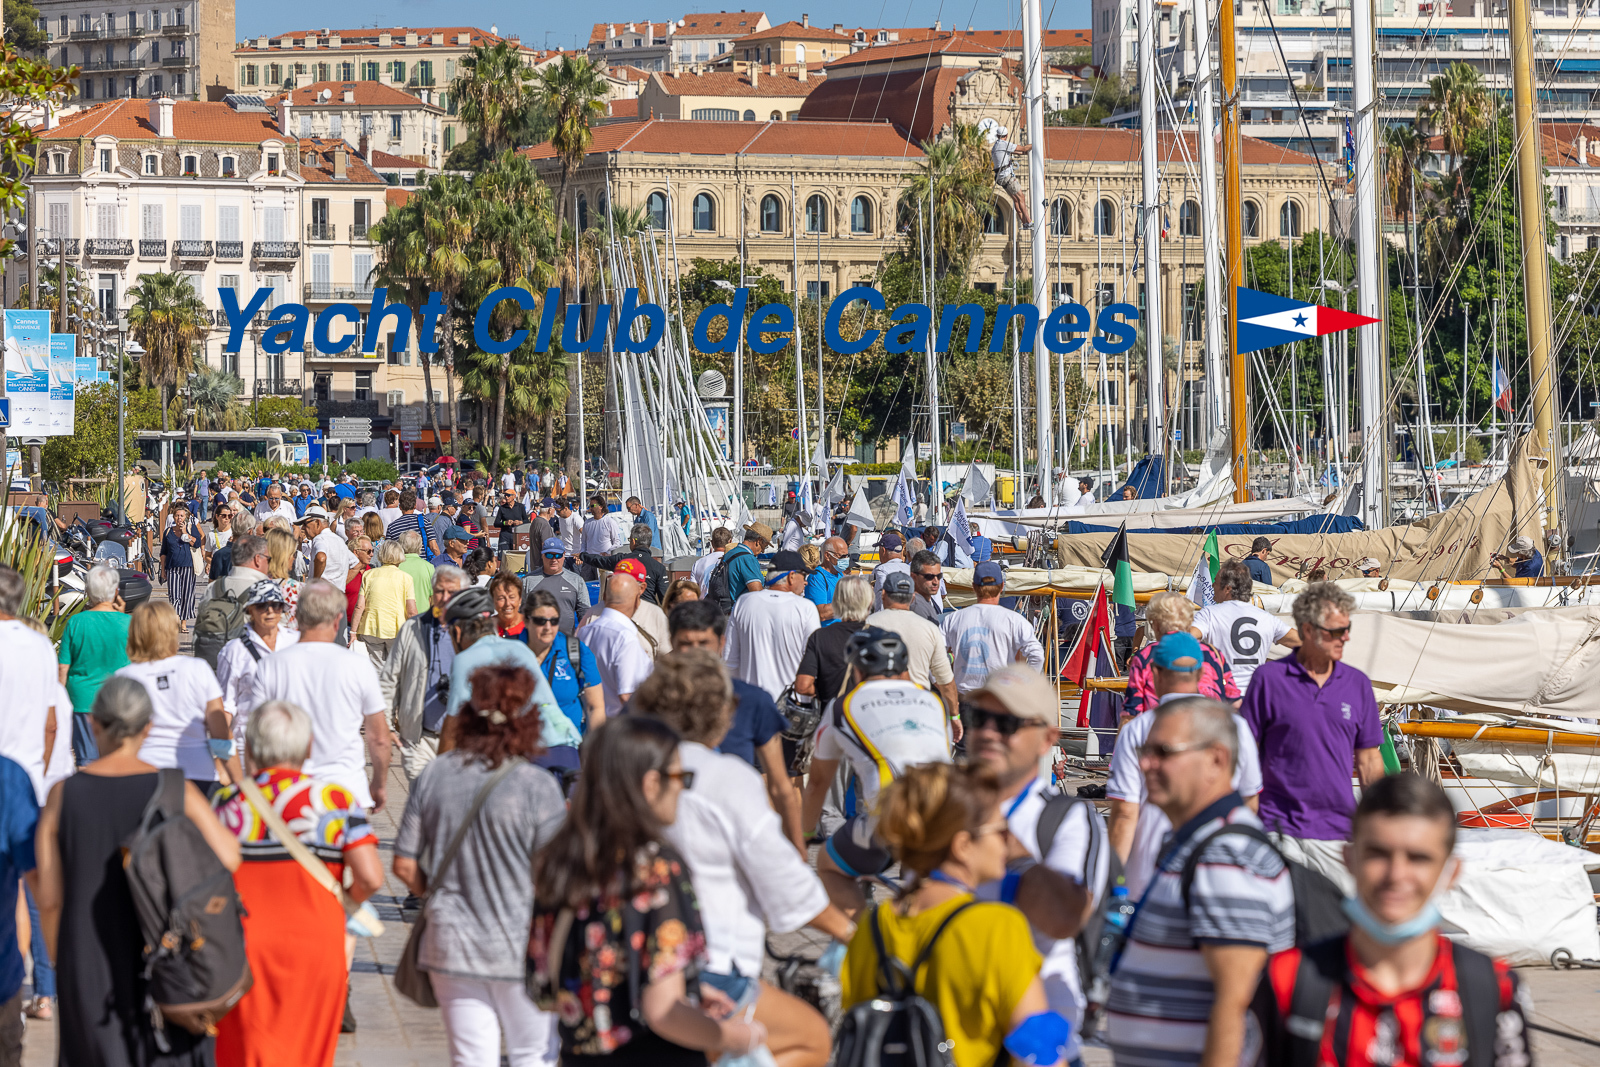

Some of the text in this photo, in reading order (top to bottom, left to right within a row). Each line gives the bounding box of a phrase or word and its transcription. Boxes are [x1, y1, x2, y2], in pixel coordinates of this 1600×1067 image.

[960, 626, 991, 666] 6
[1230, 616, 1262, 657] 6
[860, 698, 937, 712] FIDUCIAL
